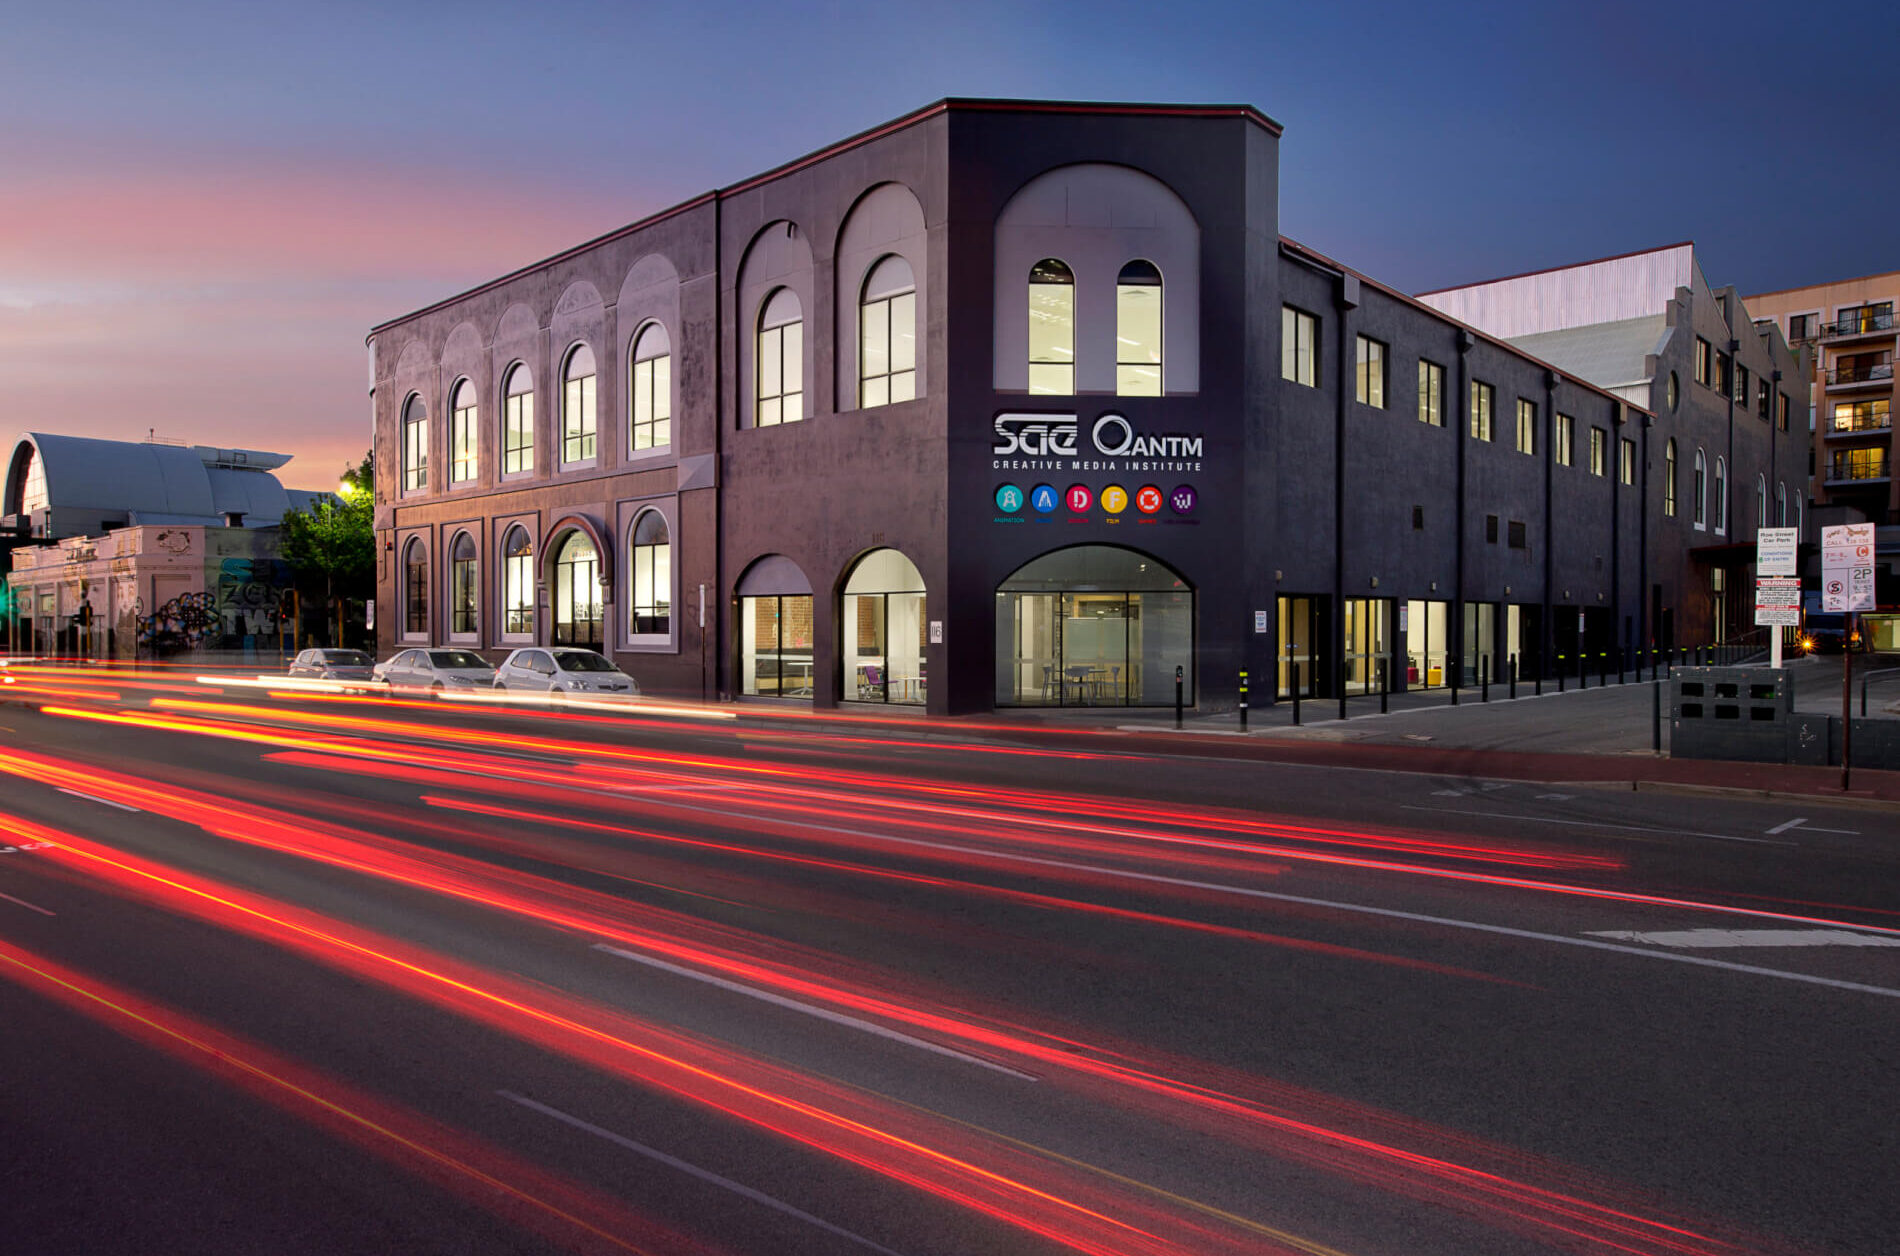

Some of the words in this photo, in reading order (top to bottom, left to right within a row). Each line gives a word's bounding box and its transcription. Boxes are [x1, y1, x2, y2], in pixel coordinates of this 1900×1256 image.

[1092, 415, 1203, 457] QANTM
[993, 460, 1062, 470] CREATIVE
[1072, 461, 1116, 470] MEDIA
[1126, 462, 1201, 471] INSTITUTE
[1853, 568, 1872, 580] 2P
[931, 626, 941, 637] 116
